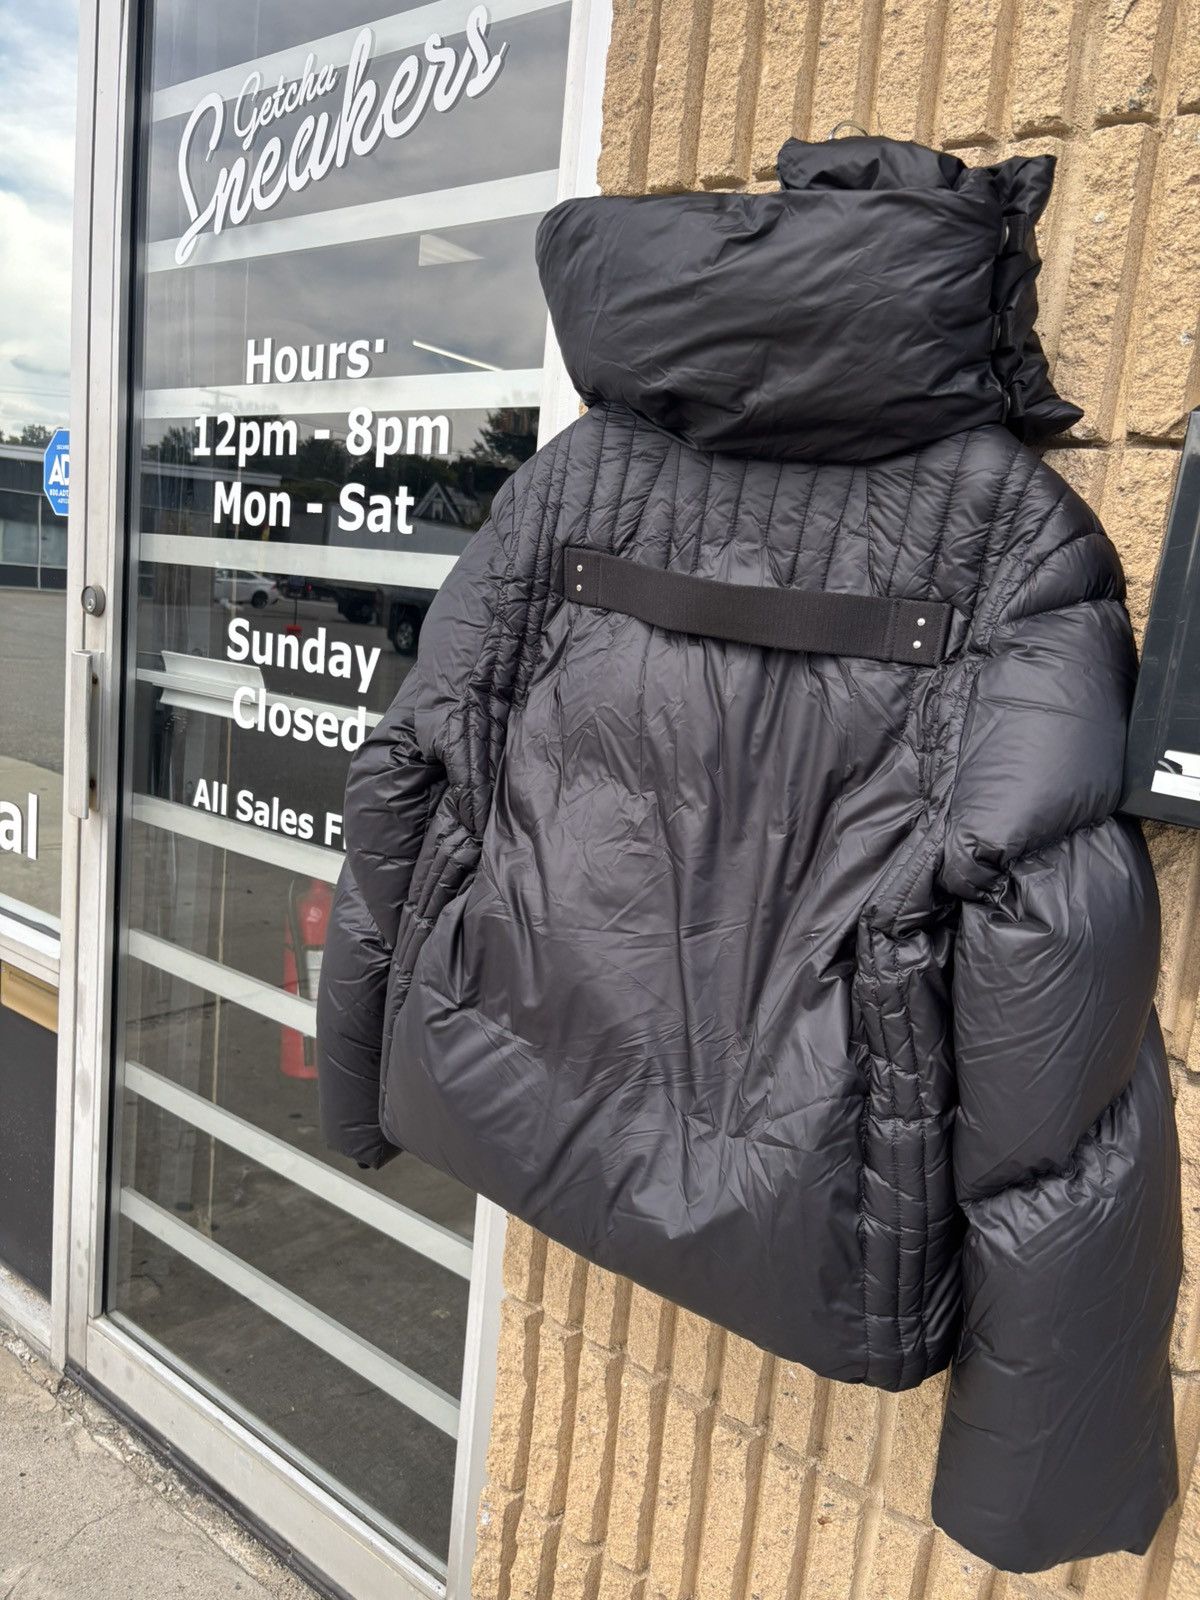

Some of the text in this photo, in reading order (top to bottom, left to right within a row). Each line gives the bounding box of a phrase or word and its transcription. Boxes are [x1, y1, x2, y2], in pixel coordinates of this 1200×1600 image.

[233, 52, 339, 150] Getcha
[174, 4, 507, 266] Sneakers
[193, 407, 450, 468] 12pm - 8pm
[213, 481, 415, 535] Mon - Sat
[226, 617, 382, 694] Sunday
[232, 686, 368, 753] Closed
[192, 778, 228, 816] All
[235, 789, 315, 840] Sales
